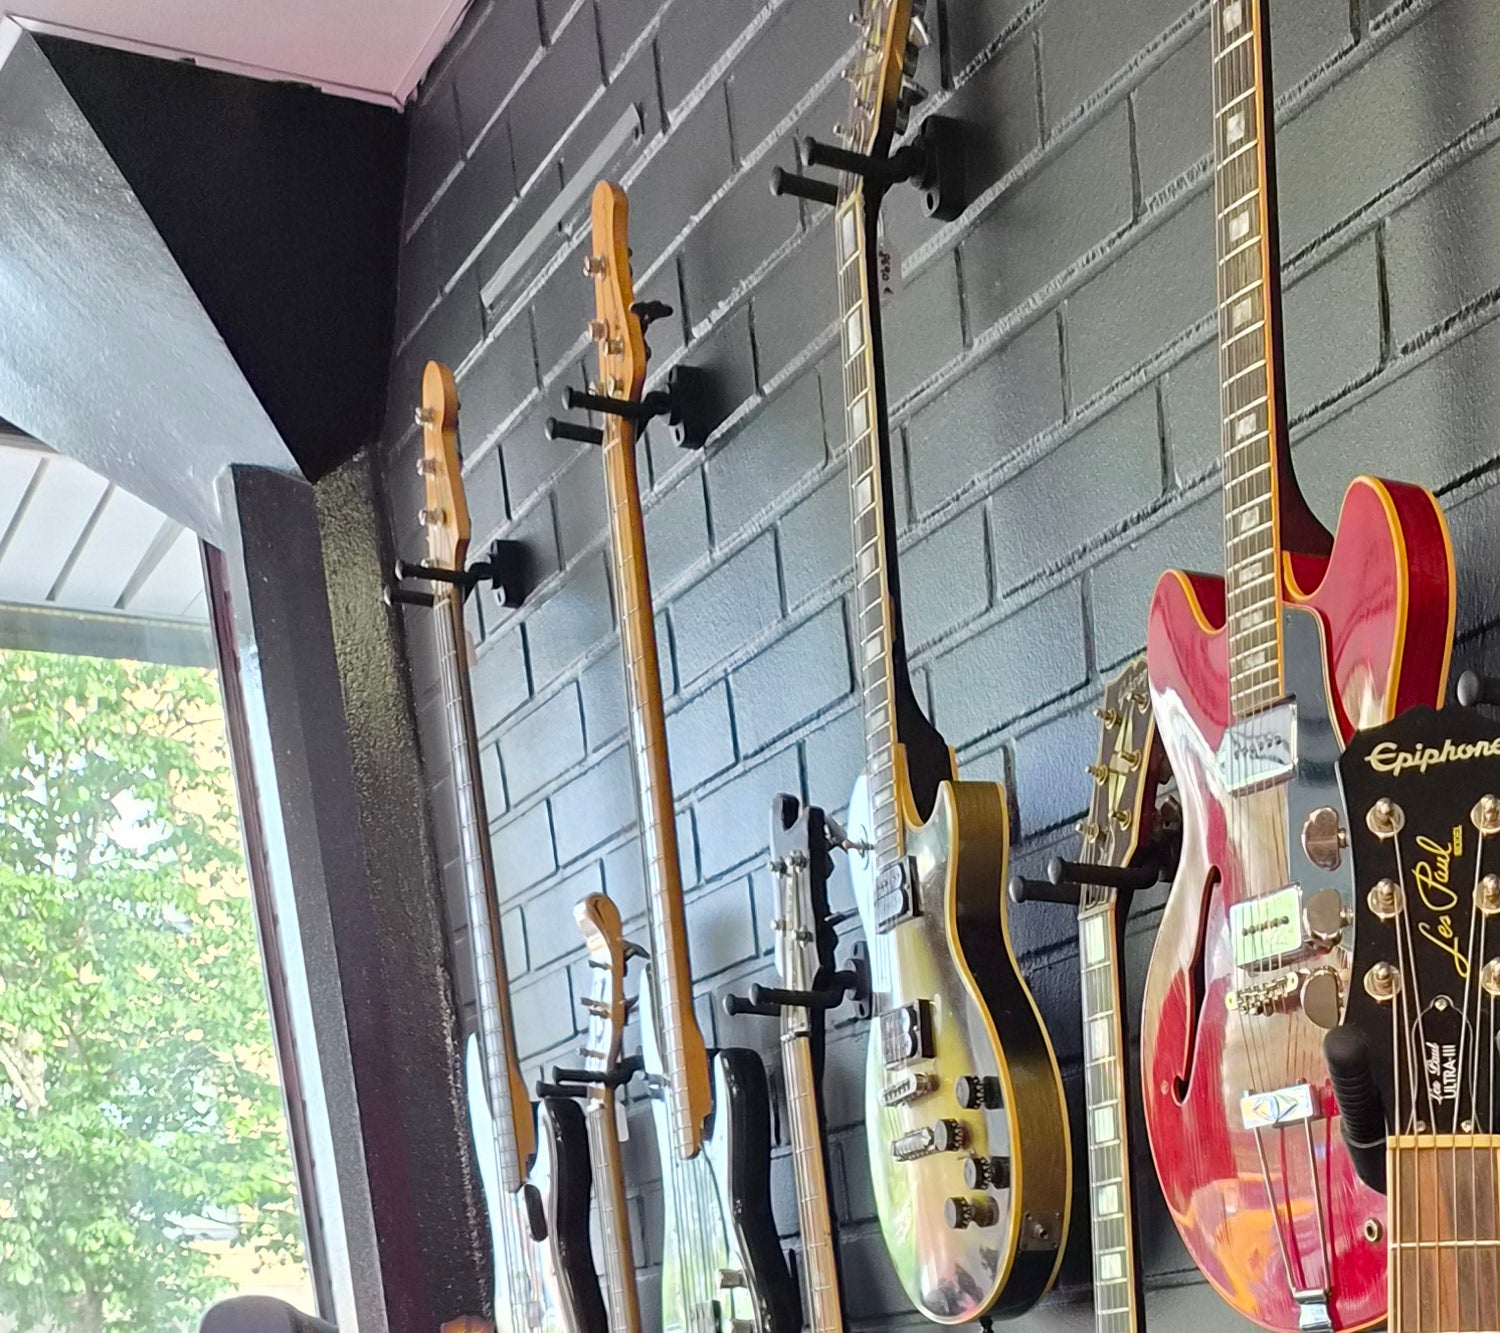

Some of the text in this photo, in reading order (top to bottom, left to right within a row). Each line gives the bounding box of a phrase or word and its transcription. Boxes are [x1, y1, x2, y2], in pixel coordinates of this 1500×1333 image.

[1411, 835, 1470, 978] Les Paul
[1425, 1041, 1443, 1106] Les Paul
[1442, 1044, 1457, 1100] ULTRA-III
